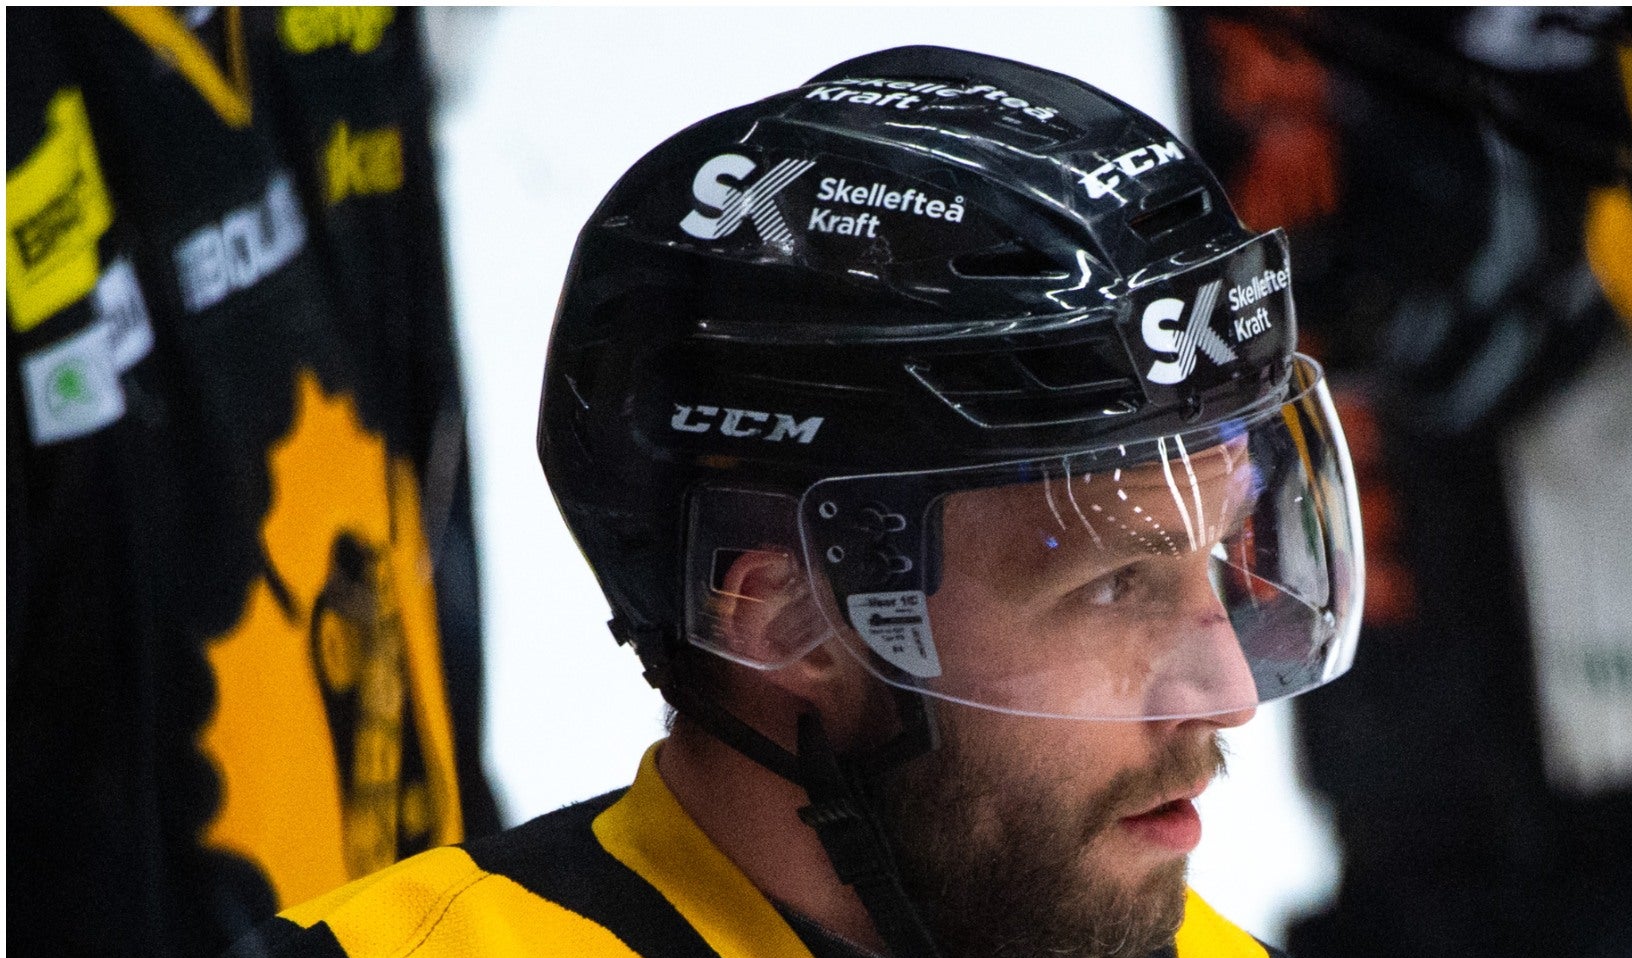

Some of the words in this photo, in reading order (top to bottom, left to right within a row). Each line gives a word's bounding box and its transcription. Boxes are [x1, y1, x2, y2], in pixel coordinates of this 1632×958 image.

[805, 86, 922, 110] Kraft
[1077, 141, 1186, 202] CCM
[817, 177, 965, 222] Skellefteå
[808, 208, 881, 238] Kraft
[1233, 307, 1273, 342] Kraft
[671, 403, 825, 444] CCM
